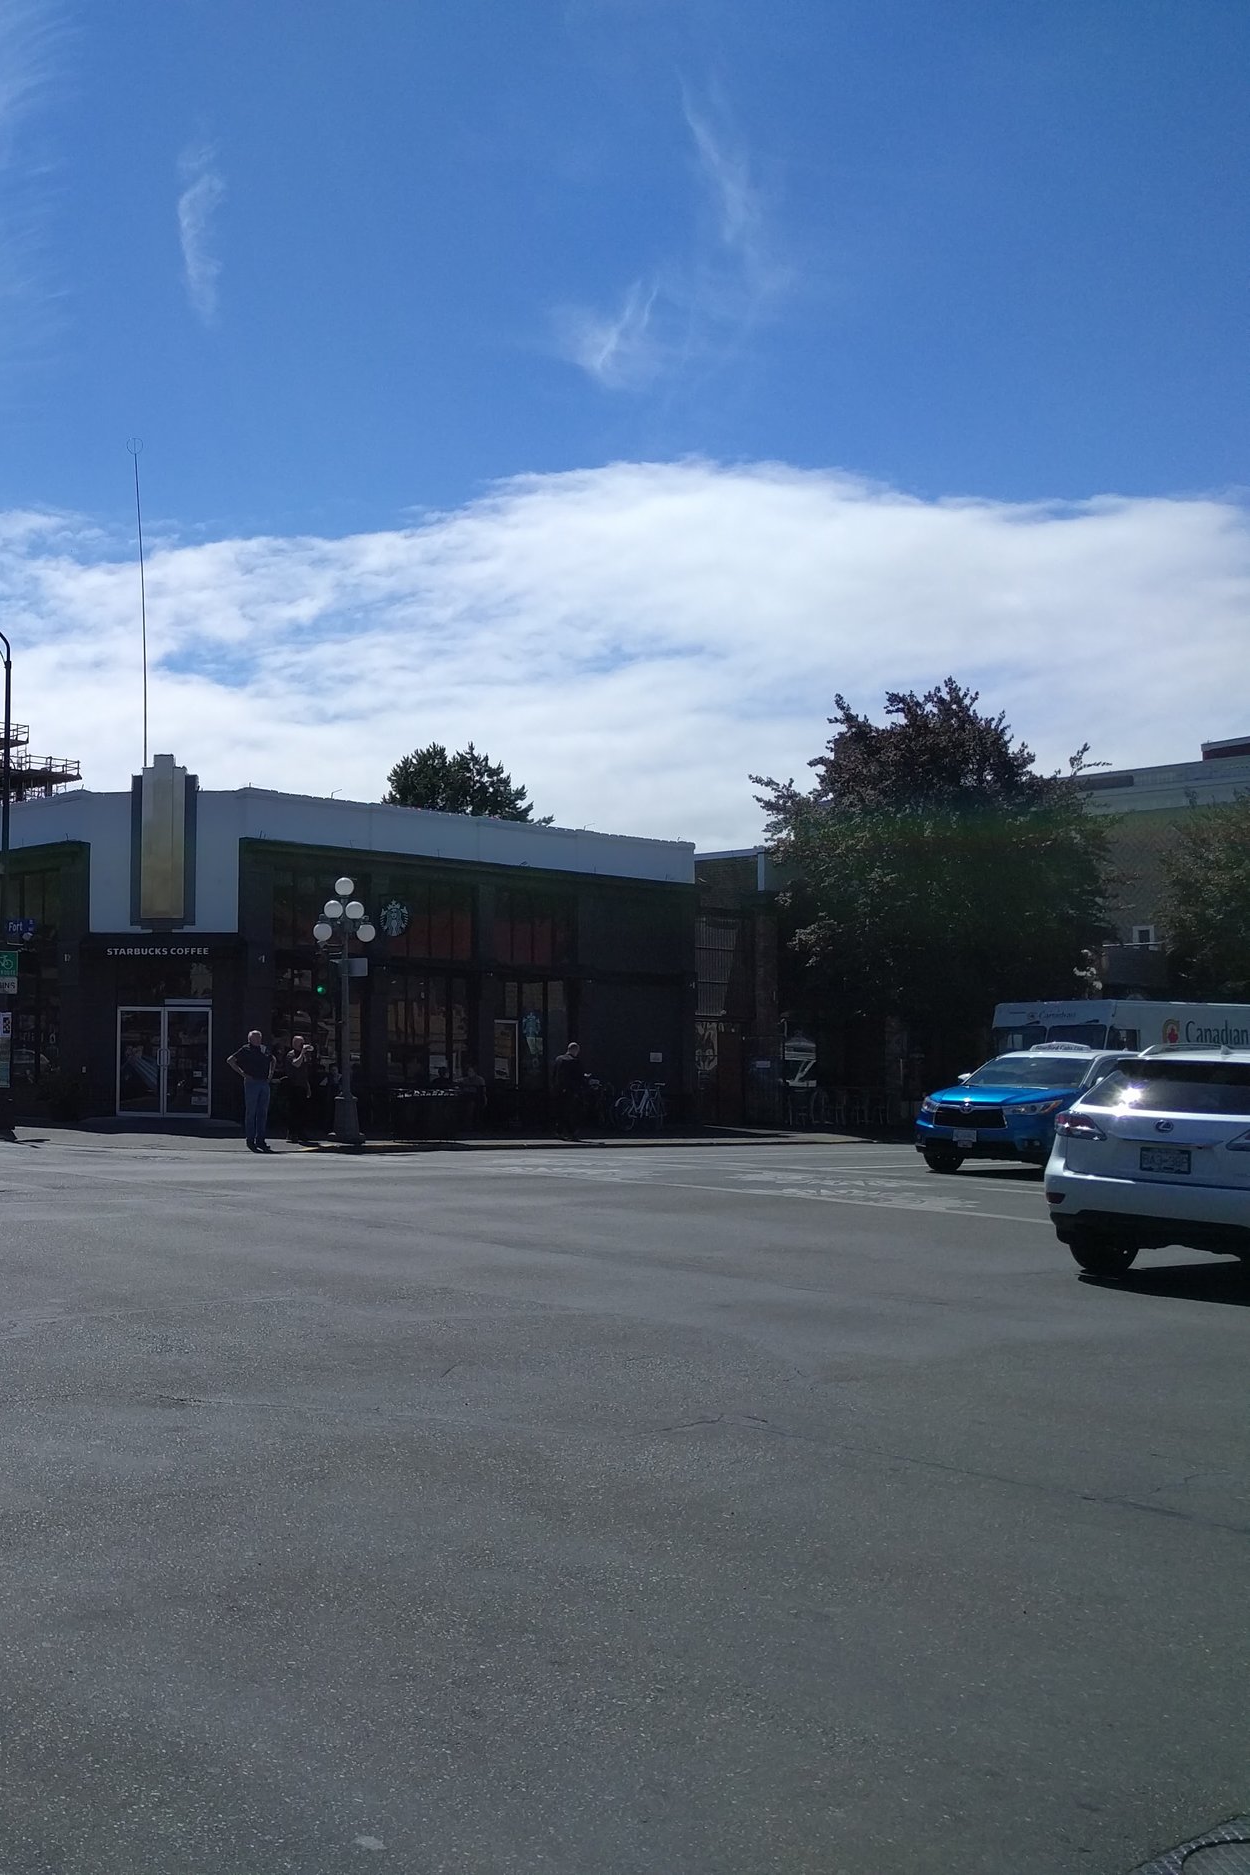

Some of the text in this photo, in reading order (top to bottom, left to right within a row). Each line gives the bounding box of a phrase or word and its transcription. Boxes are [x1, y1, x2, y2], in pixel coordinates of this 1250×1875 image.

[8, 921, 23, 932] Fort
[107, 947, 209, 955] STARBUCKS COFFEE
[1186, 1020, 1249, 1045] Canadian
